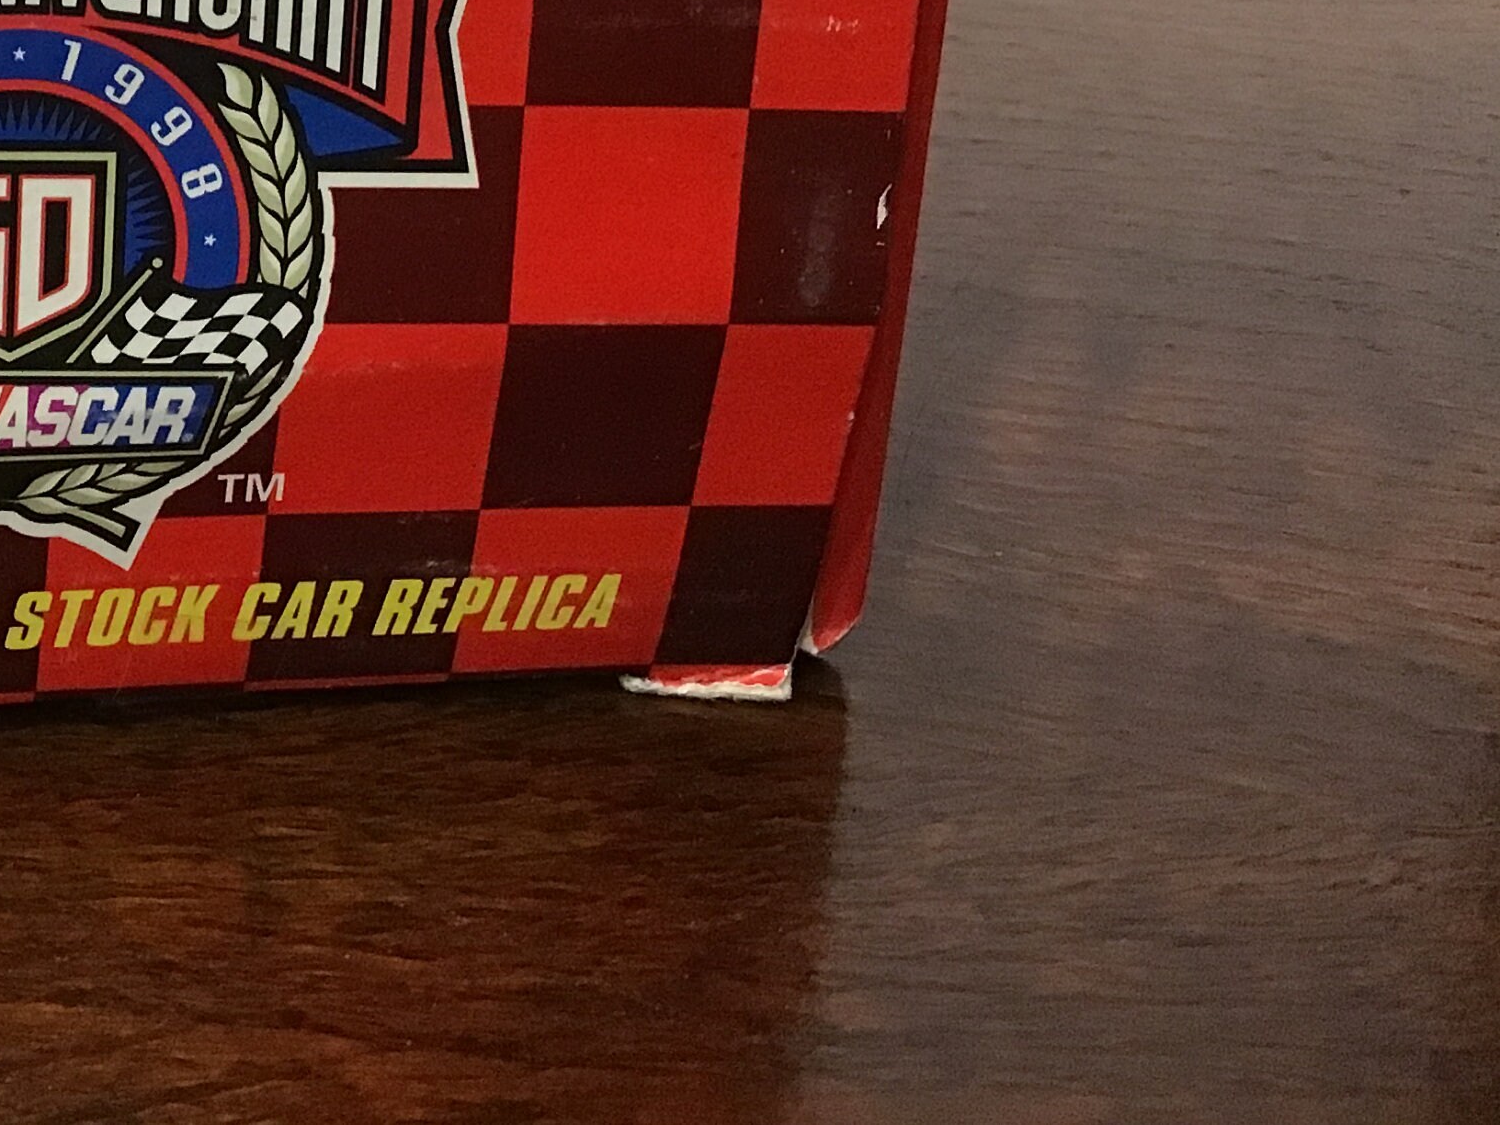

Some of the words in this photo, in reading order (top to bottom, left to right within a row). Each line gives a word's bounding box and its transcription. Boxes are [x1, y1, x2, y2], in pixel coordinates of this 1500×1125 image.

[61, 39, 223, 199] 1998
[217, 473, 286, 503] TM
[4, 584, 219, 650] STOCK
[232, 580, 365, 641] CAR
[373, 573, 621, 636] REPLICA
